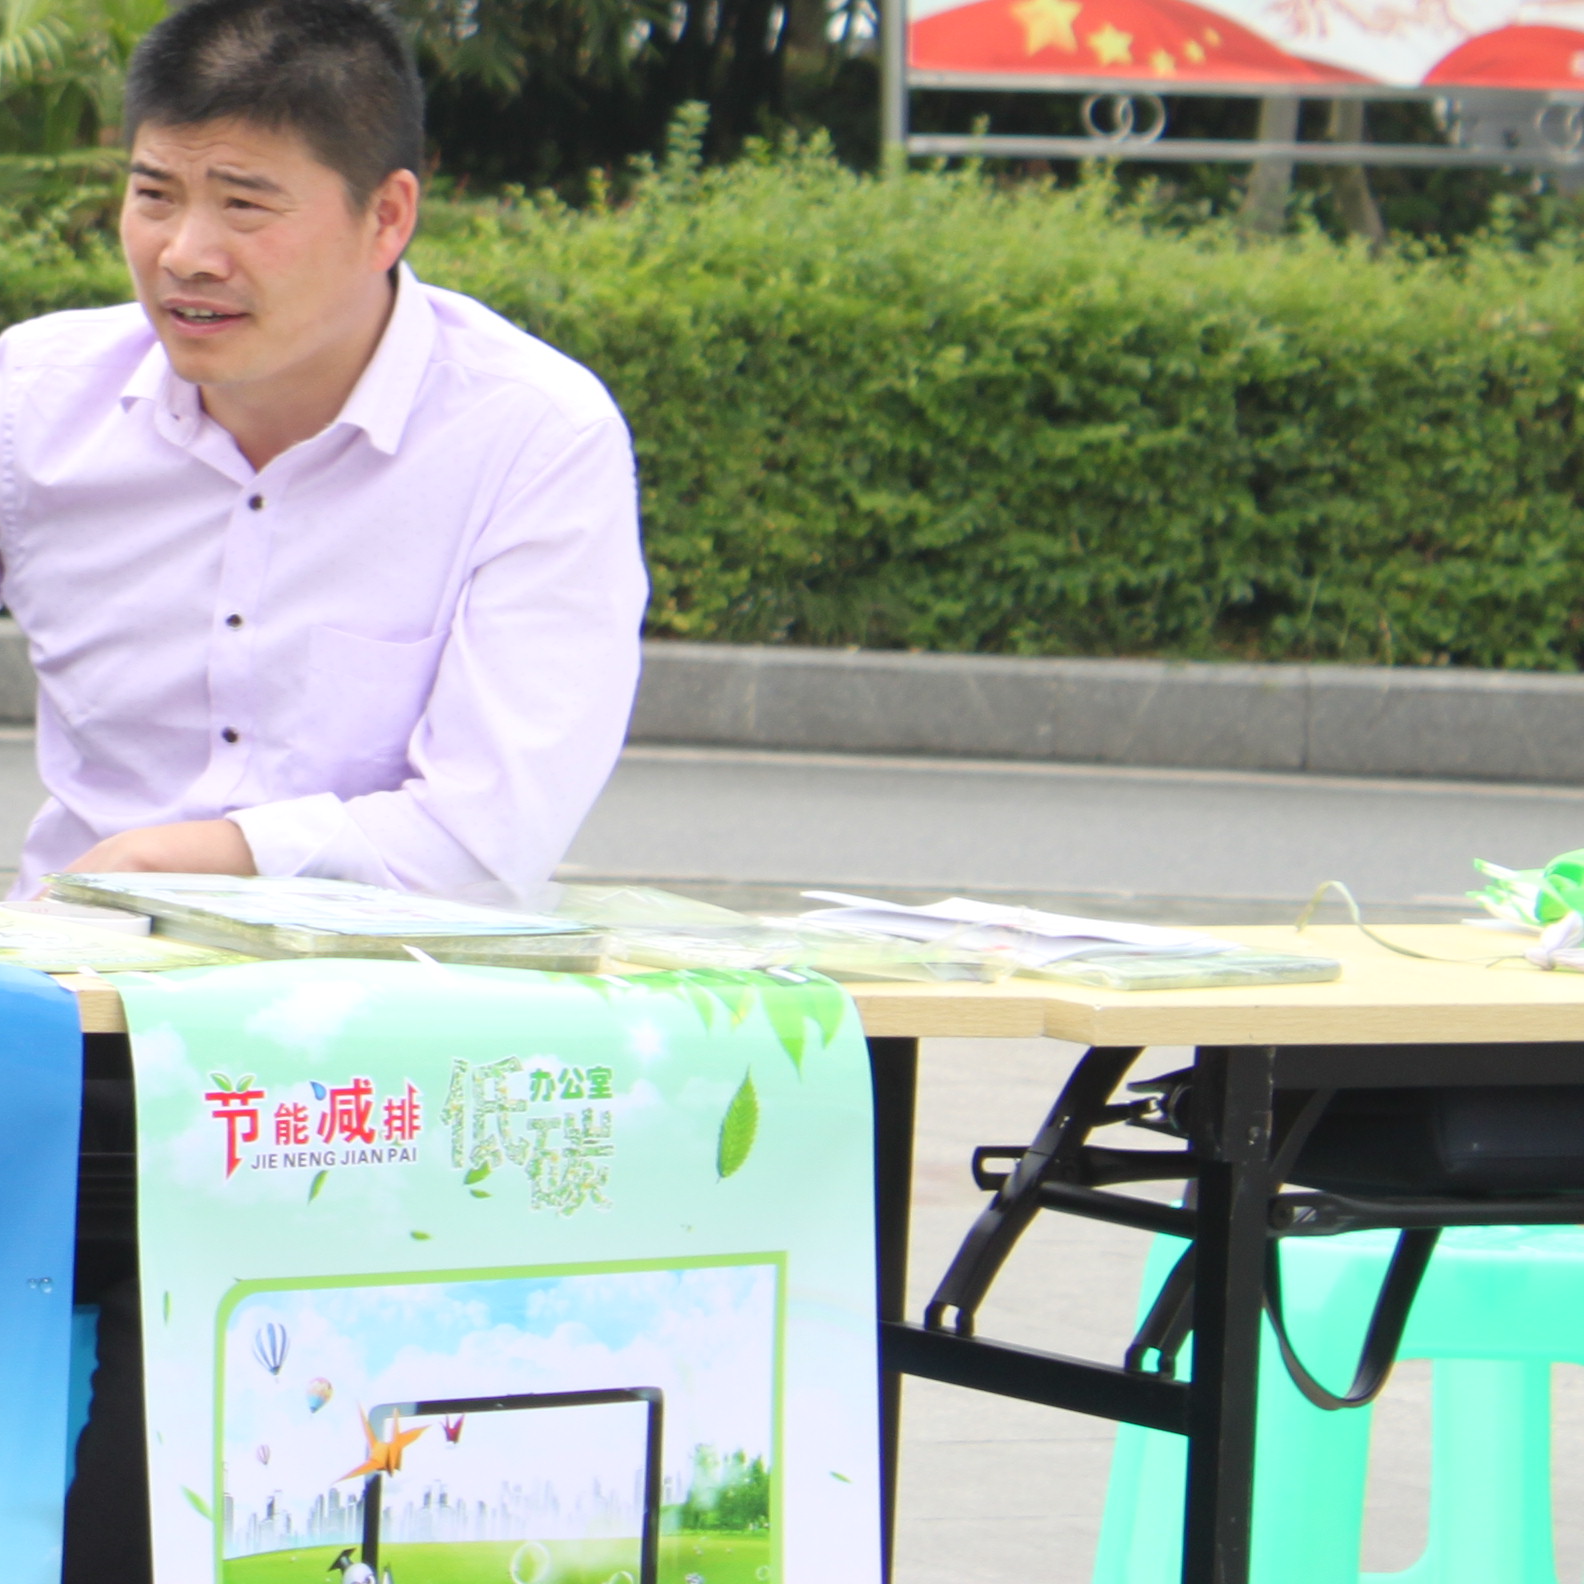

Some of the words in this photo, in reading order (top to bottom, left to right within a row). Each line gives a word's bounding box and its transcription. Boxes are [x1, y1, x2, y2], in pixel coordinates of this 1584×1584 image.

[529, 1066, 614, 1102] 办公室
[205, 1076, 422, 1180] 节能减排
[251, 1153, 278, 1170] JIE
[283, 1151, 336, 1169] NENG
[340, 1150, 383, 1167] JIAN
[388, 1147, 418, 1164] PAI
